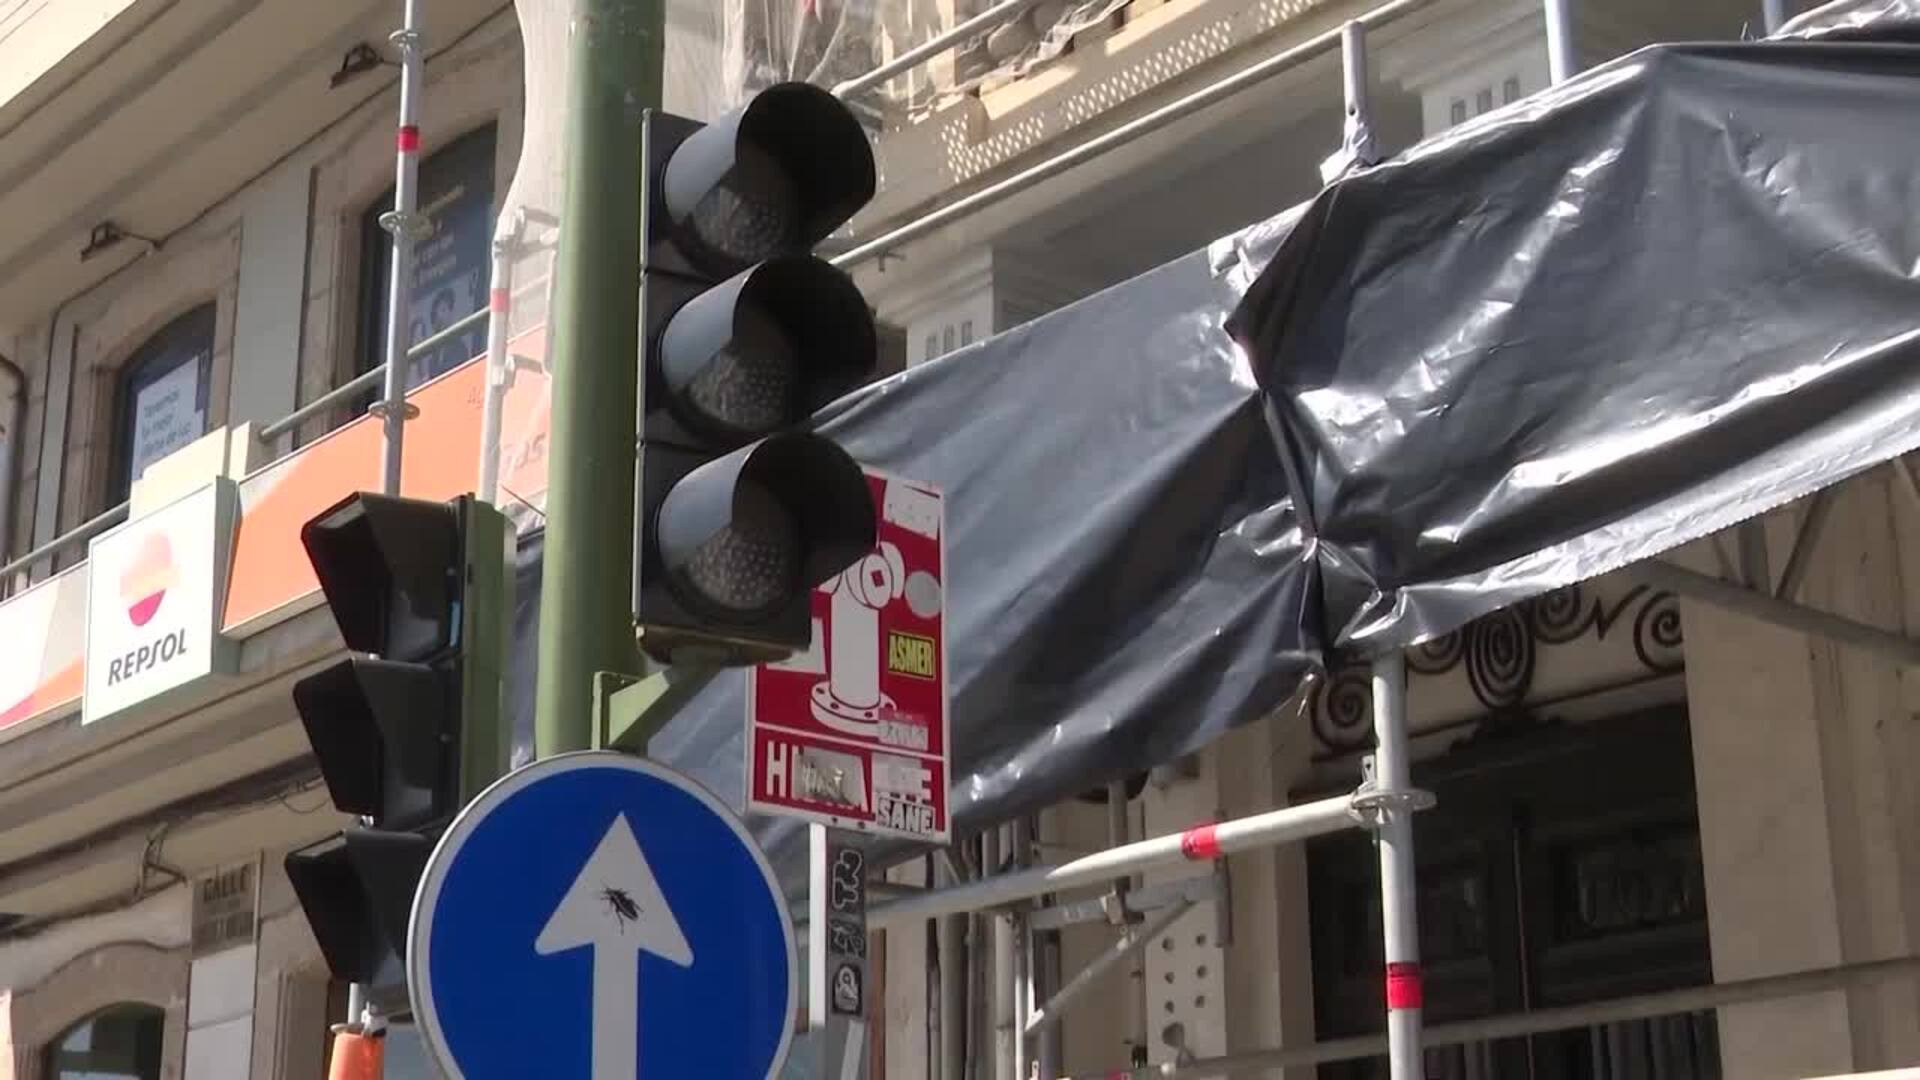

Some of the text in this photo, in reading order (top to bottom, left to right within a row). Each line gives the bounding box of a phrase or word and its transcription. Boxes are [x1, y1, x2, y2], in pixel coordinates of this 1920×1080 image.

[107, 627, 187, 686] REPSOL
[888, 634, 933, 675] ASMER
[877, 799, 934, 834] SANE
